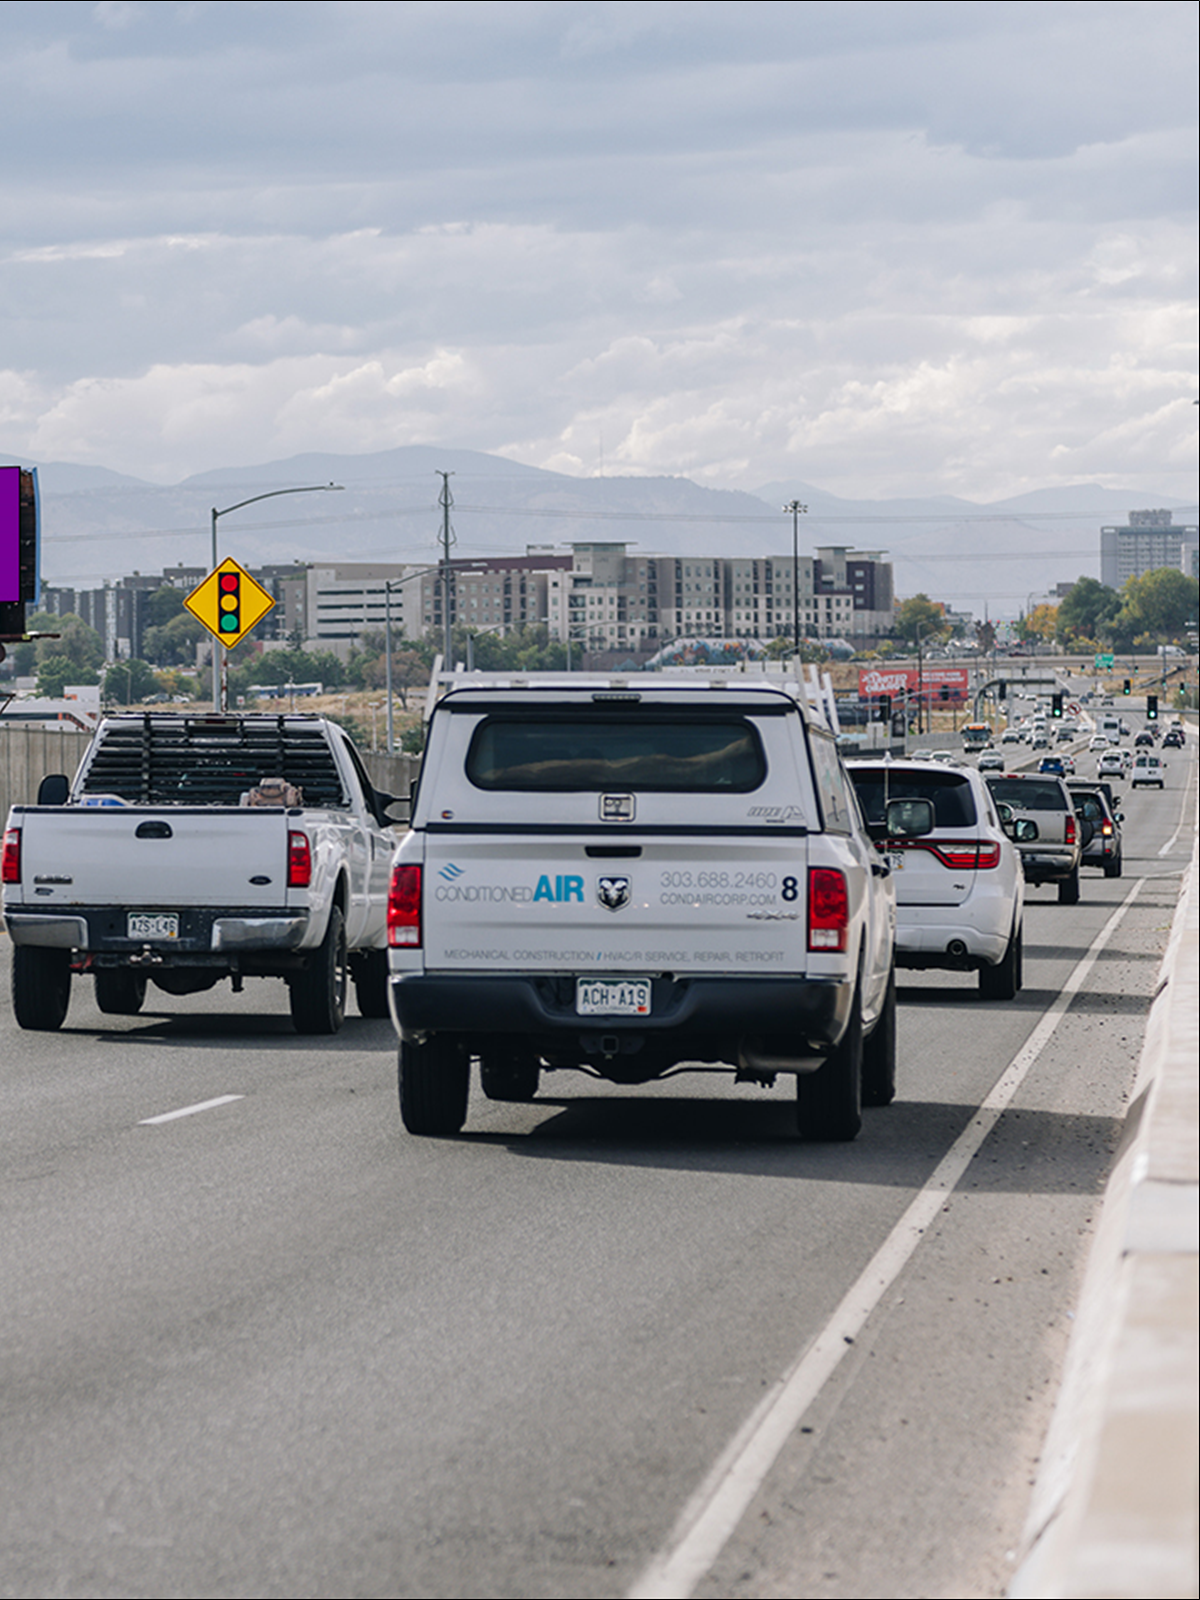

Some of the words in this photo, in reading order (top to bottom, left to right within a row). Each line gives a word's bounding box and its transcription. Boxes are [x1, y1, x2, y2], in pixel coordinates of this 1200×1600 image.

[660, 871, 777, 889] 303.688.2460
[781, 876, 799, 902] 8
[659, 892, 777, 906] CONDAIRCORP.COM
[443, 949, 510, 960] MECHANICAL
[513, 950, 595, 961] CONSTRUCTION
[603, 950, 643, 962] HVAC/R
[645, 950, 691, 963] SERVICE,
[693, 950, 733, 963] REPAIR,
[735, 950, 785, 962] RETROFIT
